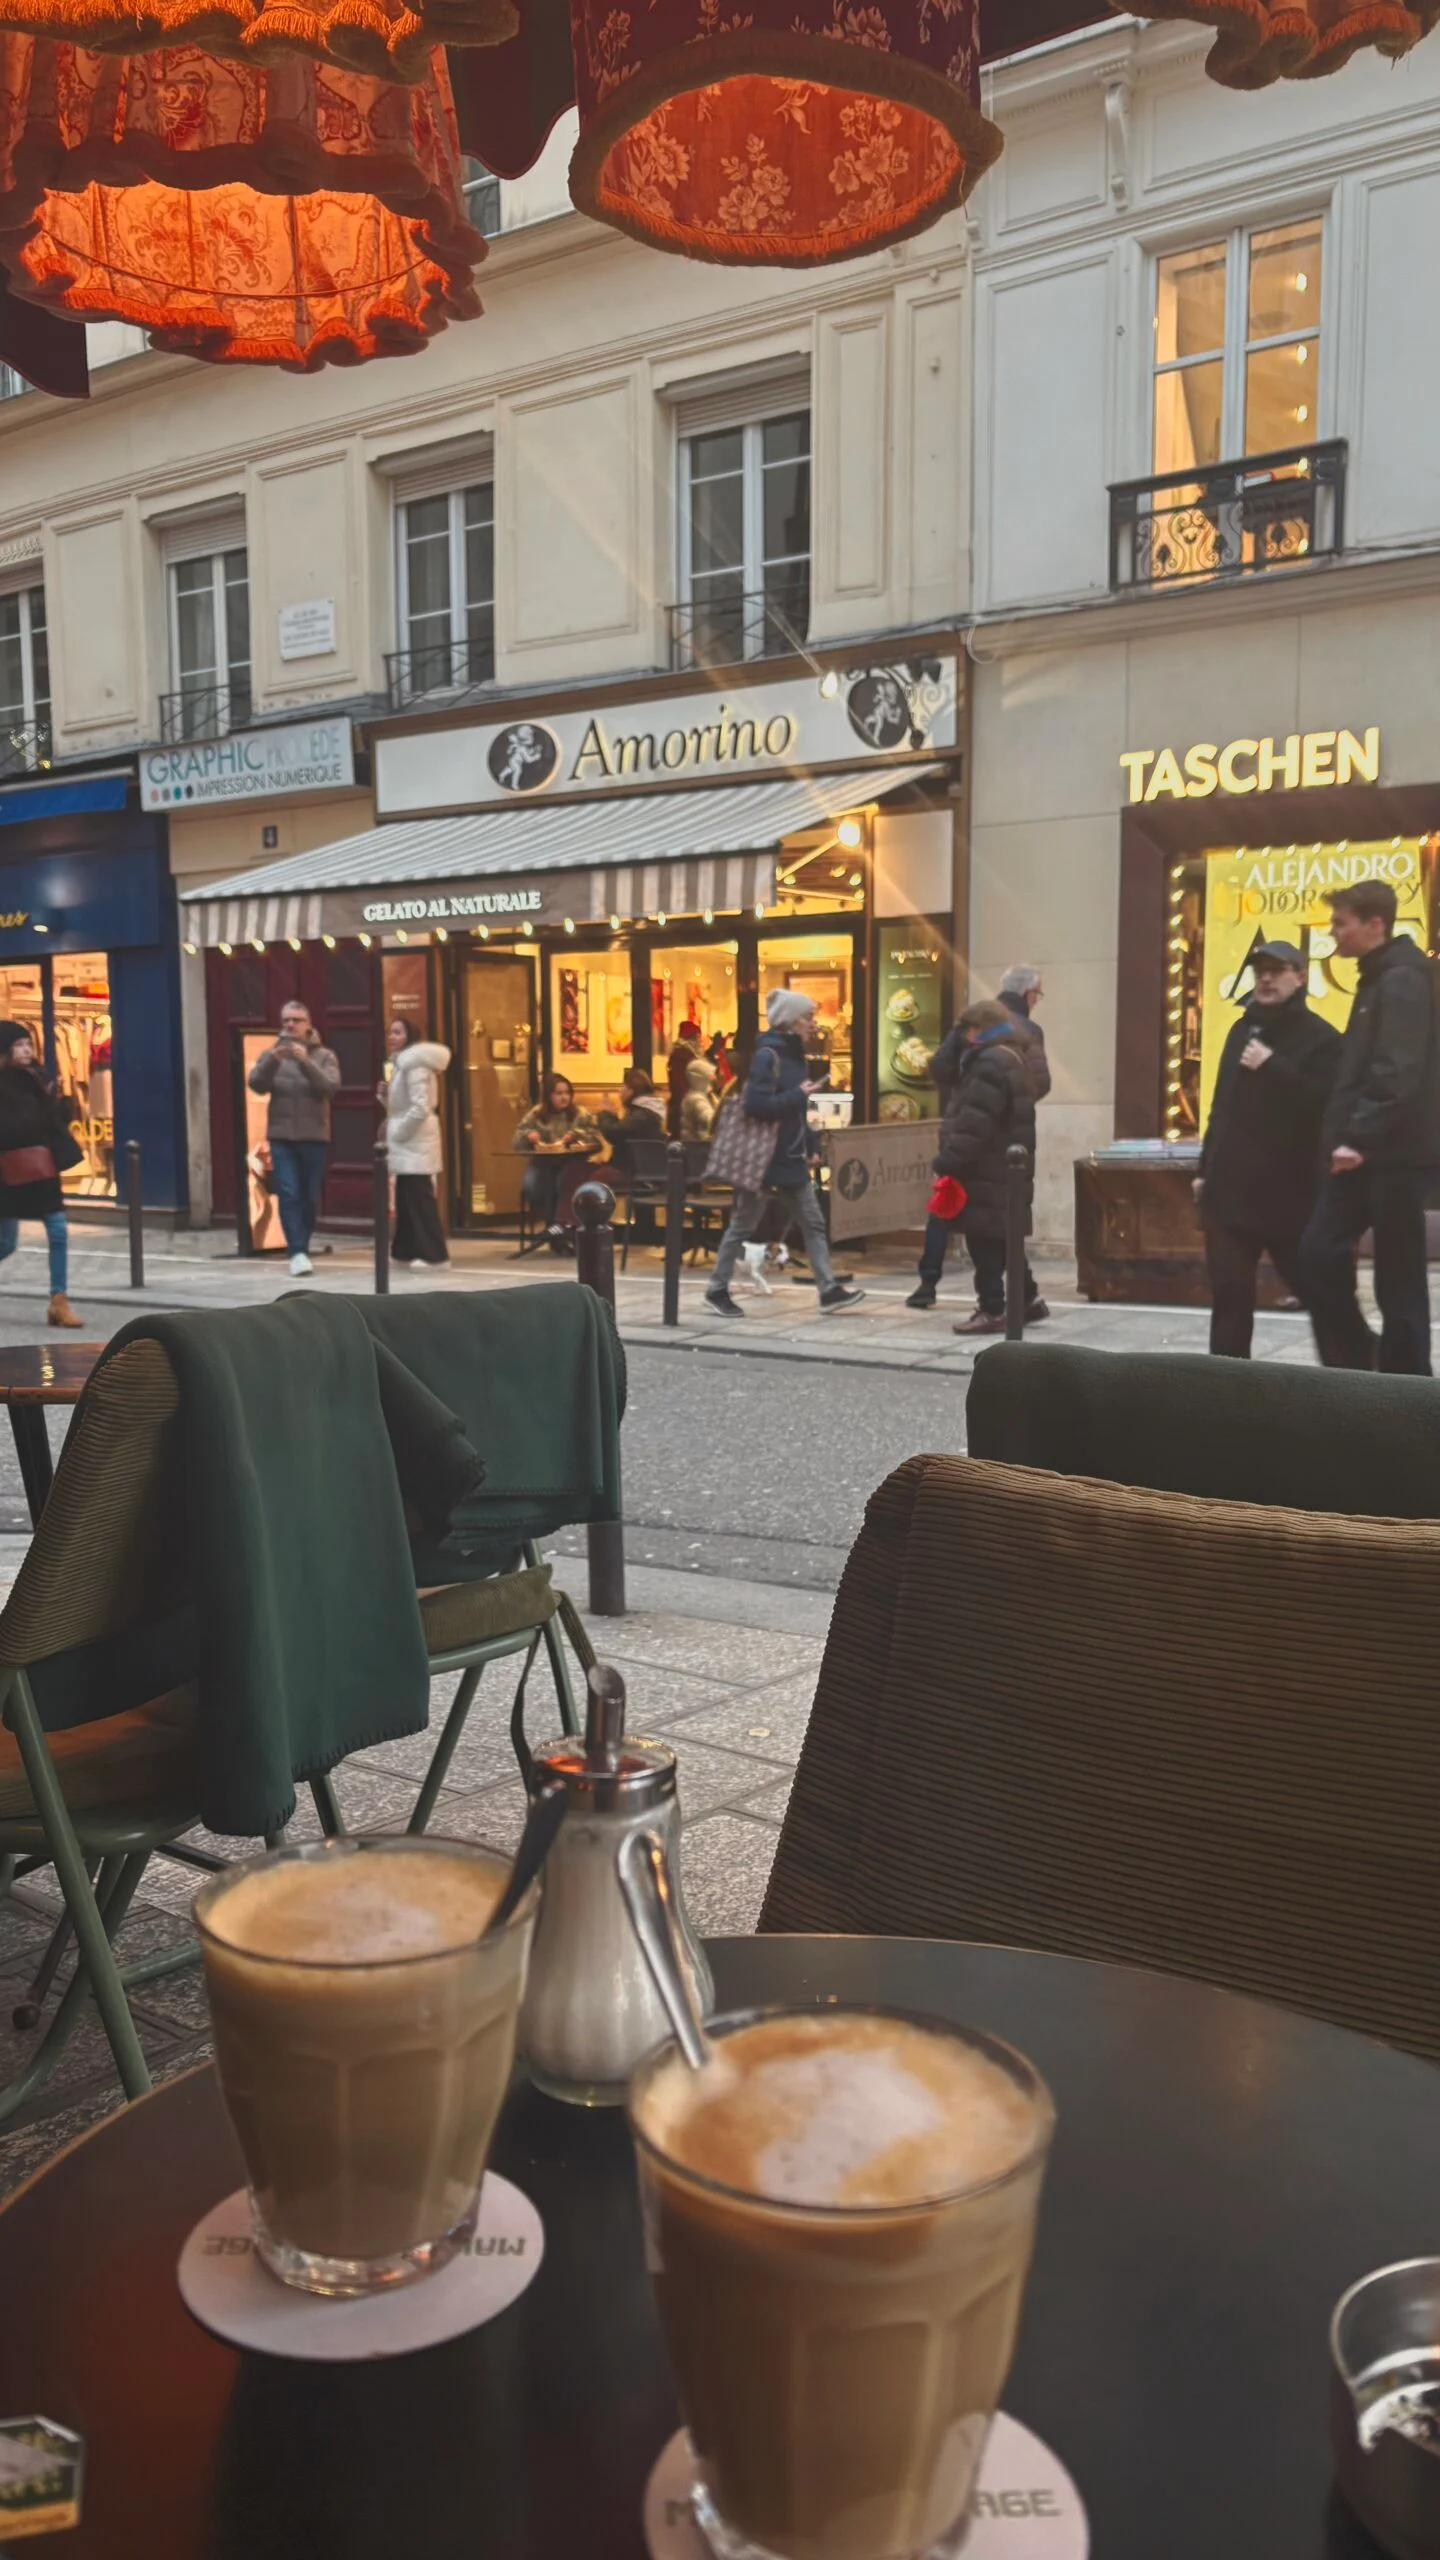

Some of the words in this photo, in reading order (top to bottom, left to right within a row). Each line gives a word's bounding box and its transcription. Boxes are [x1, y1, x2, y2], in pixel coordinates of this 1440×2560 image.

[146, 738, 265, 785] GRAPHIC
[567, 704, 792, 780] Amorino
[1119, 726, 1380, 803] TASCHEN
[196, 772, 266, 799] IMPRESSION
[1244, 851, 1415, 895] ALEJANDRO
[363, 898, 428, 922] GELATO
[427, 895, 451, 918] AL
[450, 890, 543, 916] NATURALE
